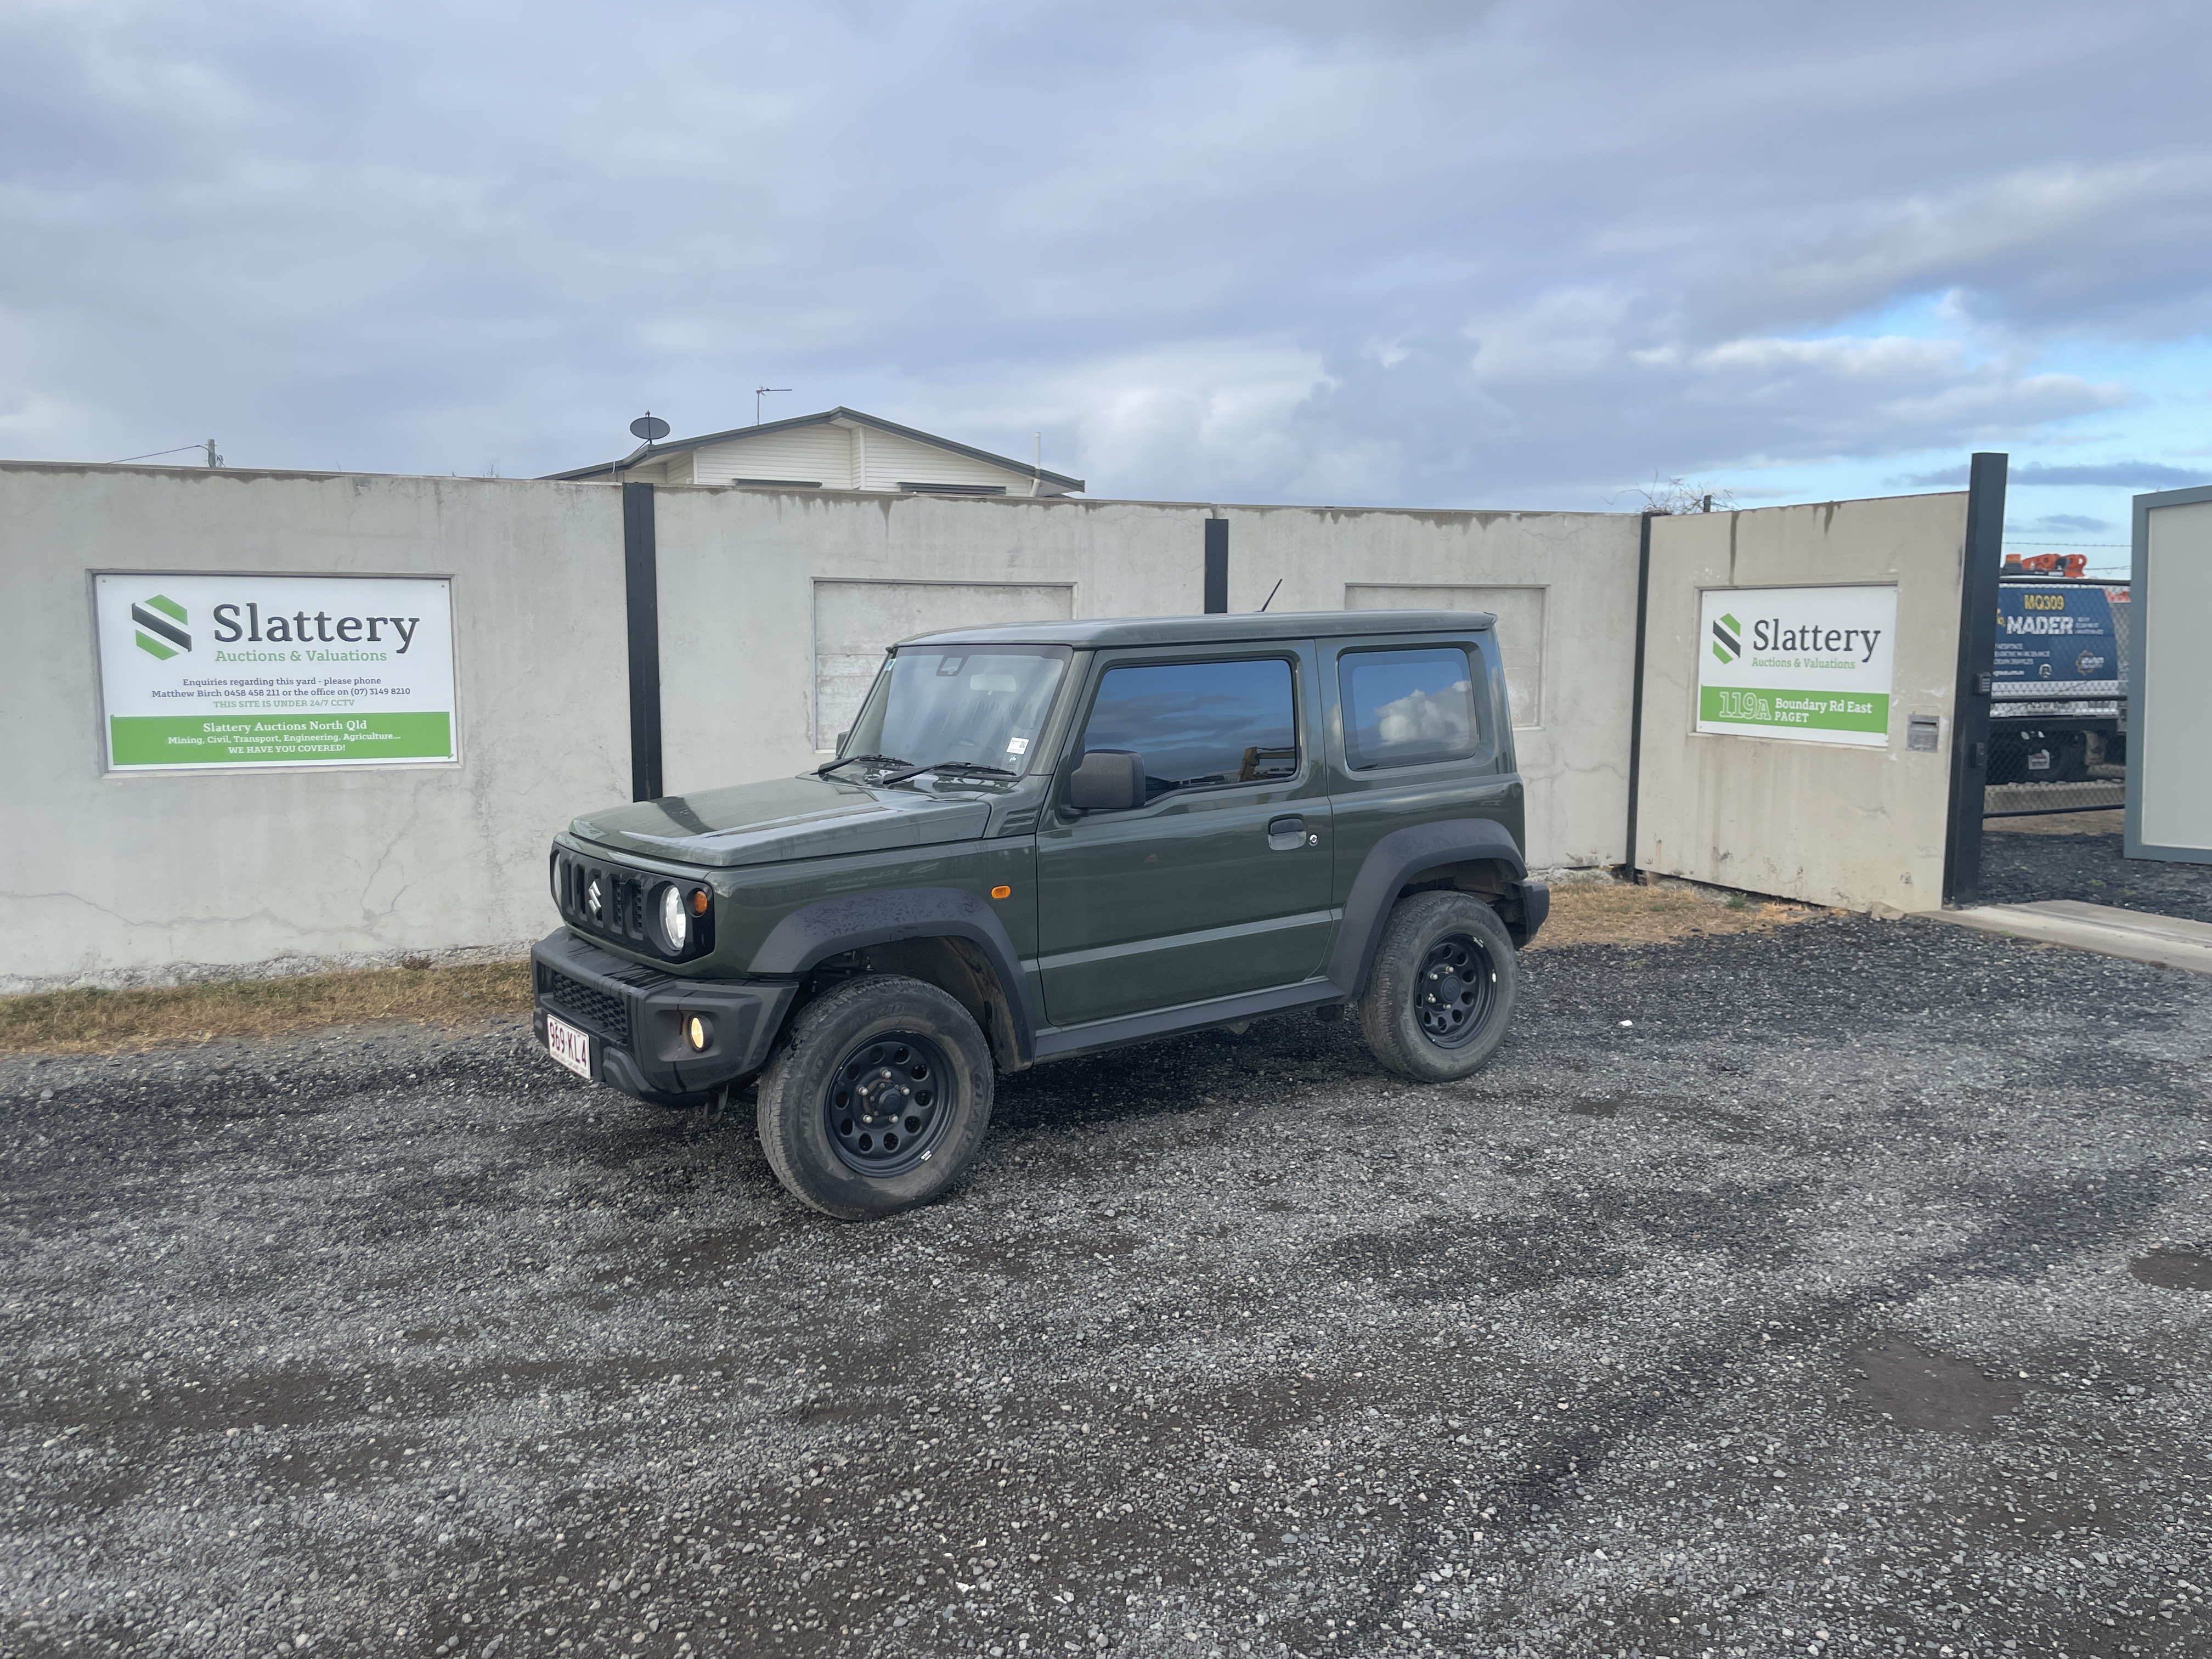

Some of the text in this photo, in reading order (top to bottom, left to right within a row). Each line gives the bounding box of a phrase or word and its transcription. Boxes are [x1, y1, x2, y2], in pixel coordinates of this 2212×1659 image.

[213, 602, 420, 654] Slattery
[2006, 616, 2074, 635] MADER
[1753, 618, 1881, 663] Slattery
[215, 649, 387, 662] Auctions & Valuations
[1752, 657, 1855, 669] Auctions & Valuations
[183, 679, 227, 687] Enquiries
[230, 678, 274, 687] regarding
[296, 678, 316, 686] yard
[324, 678, 352, 686] please
[354, 677, 381, 686] phone
[351, 688, 368, 696] (07)
[1719, 691, 1771, 720] 119A
[1775, 697, 1873, 714] Boundary Rd East
[1774, 713, 1809, 723] PAGET
[204, 720, 367, 733] Slattery Auctions North Qld
[168, 737, 205, 745] Mining,
[207, 735, 232, 743] Civil,
[284, 733, 341, 743] Engineering,
[343, 732, 401, 742] Agriculture...
